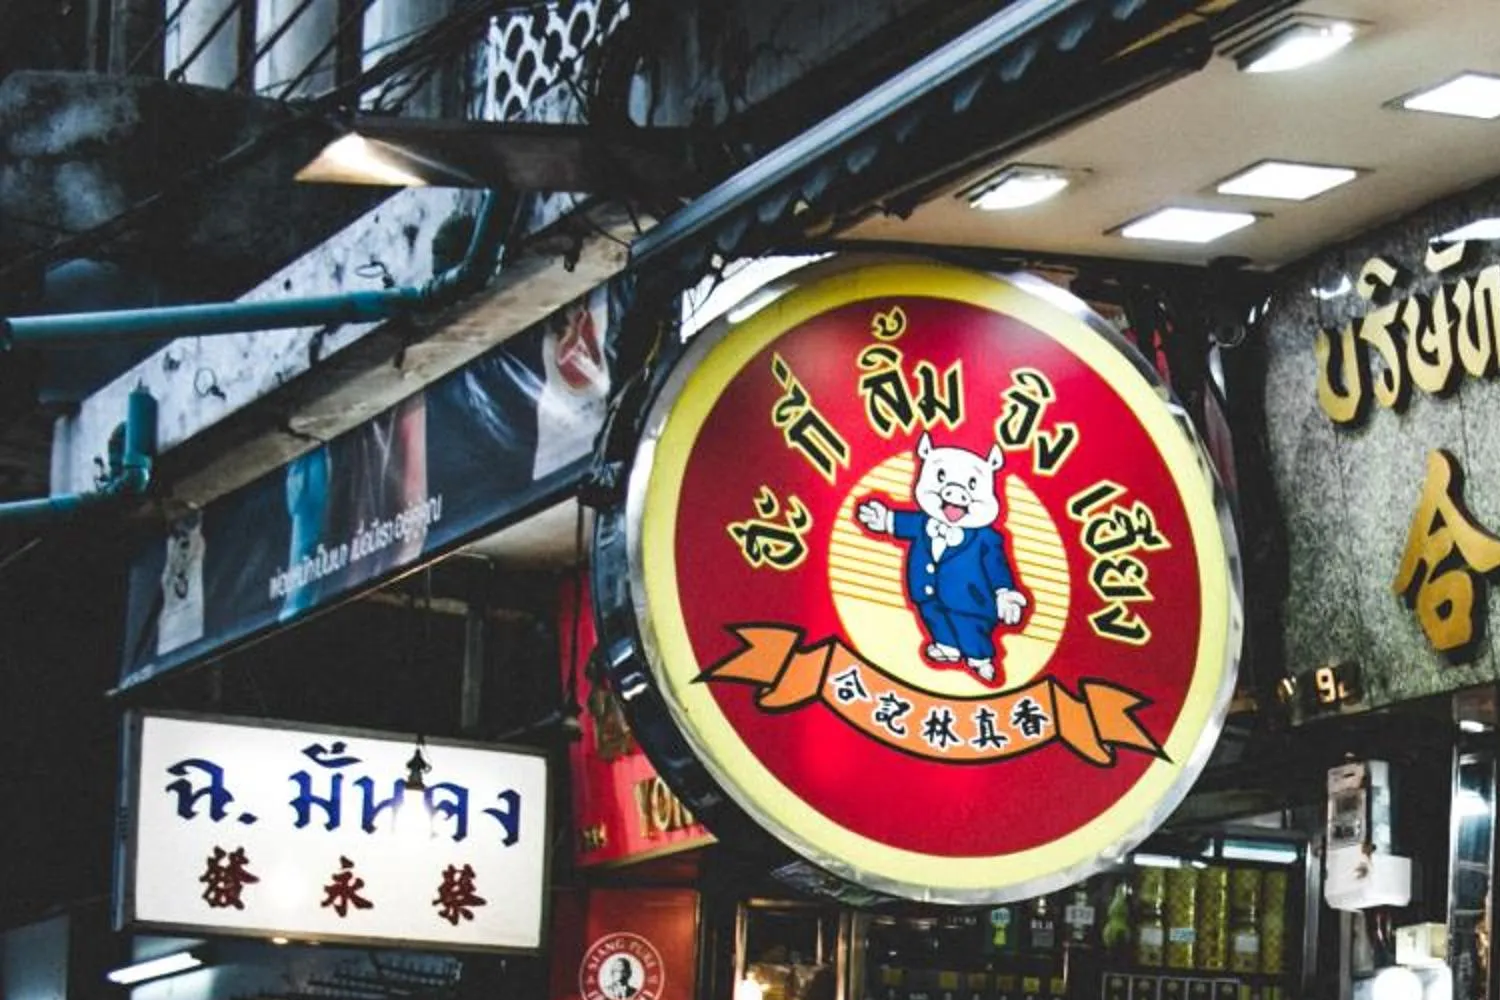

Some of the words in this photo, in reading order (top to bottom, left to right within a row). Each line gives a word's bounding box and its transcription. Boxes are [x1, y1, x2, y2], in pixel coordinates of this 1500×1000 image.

[833, 669, 1048, 749] 合記林真香
